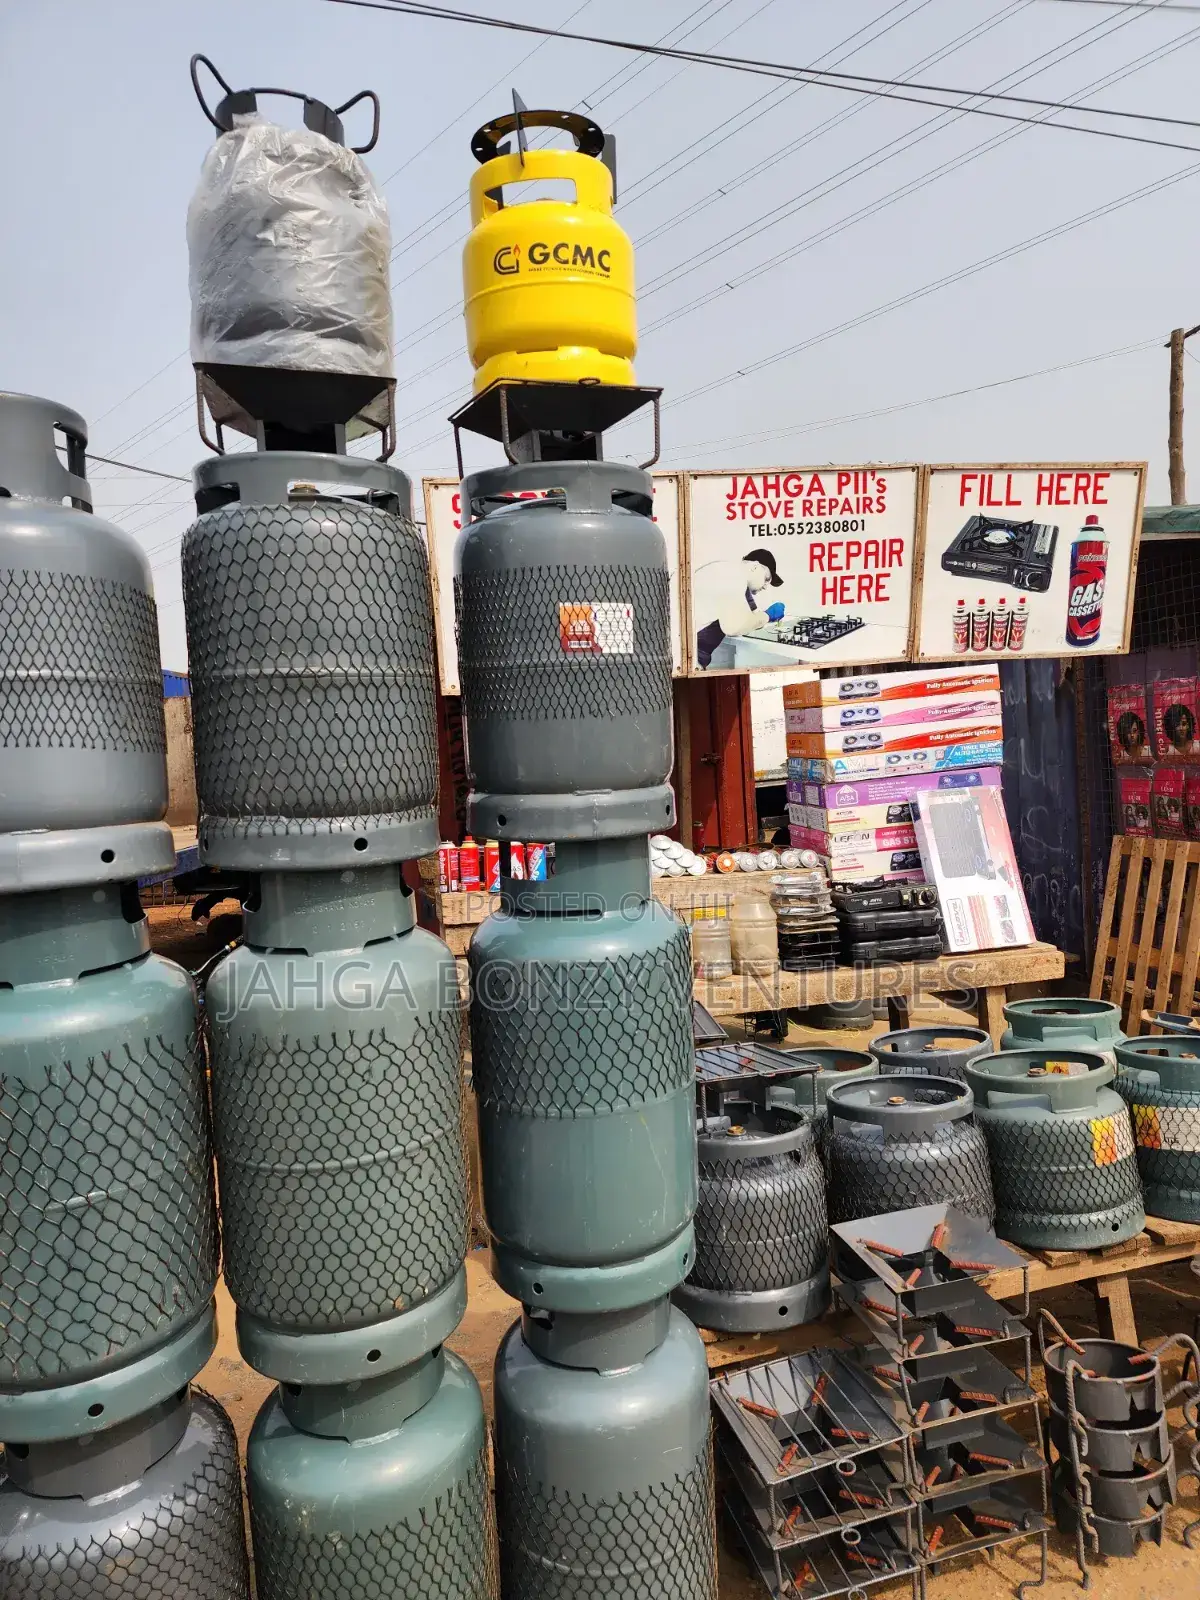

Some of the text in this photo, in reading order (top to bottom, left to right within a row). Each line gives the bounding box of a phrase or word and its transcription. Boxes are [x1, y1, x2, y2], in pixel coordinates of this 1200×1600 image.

[528, 242, 611, 273] GCMC
[725, 472, 826, 501] JAHGA
[959, 472, 1111, 507] FILL HERE
[726, 495, 887, 521] STOVE REPAIRS
[749, 519, 866, 537] TEL:0552380801
[809, 538, 905, 573] REPAIR
[821, 573, 892, 606] HERE
[1070, 579, 1104, 607] GAS
[942, 679, 971, 688] Automatic
[972, 677, 994, 685] Ignition
[945, 731, 974, 740] Automatic
[975, 729, 997, 737] Ignition
[882, 836, 902, 848] GAS
